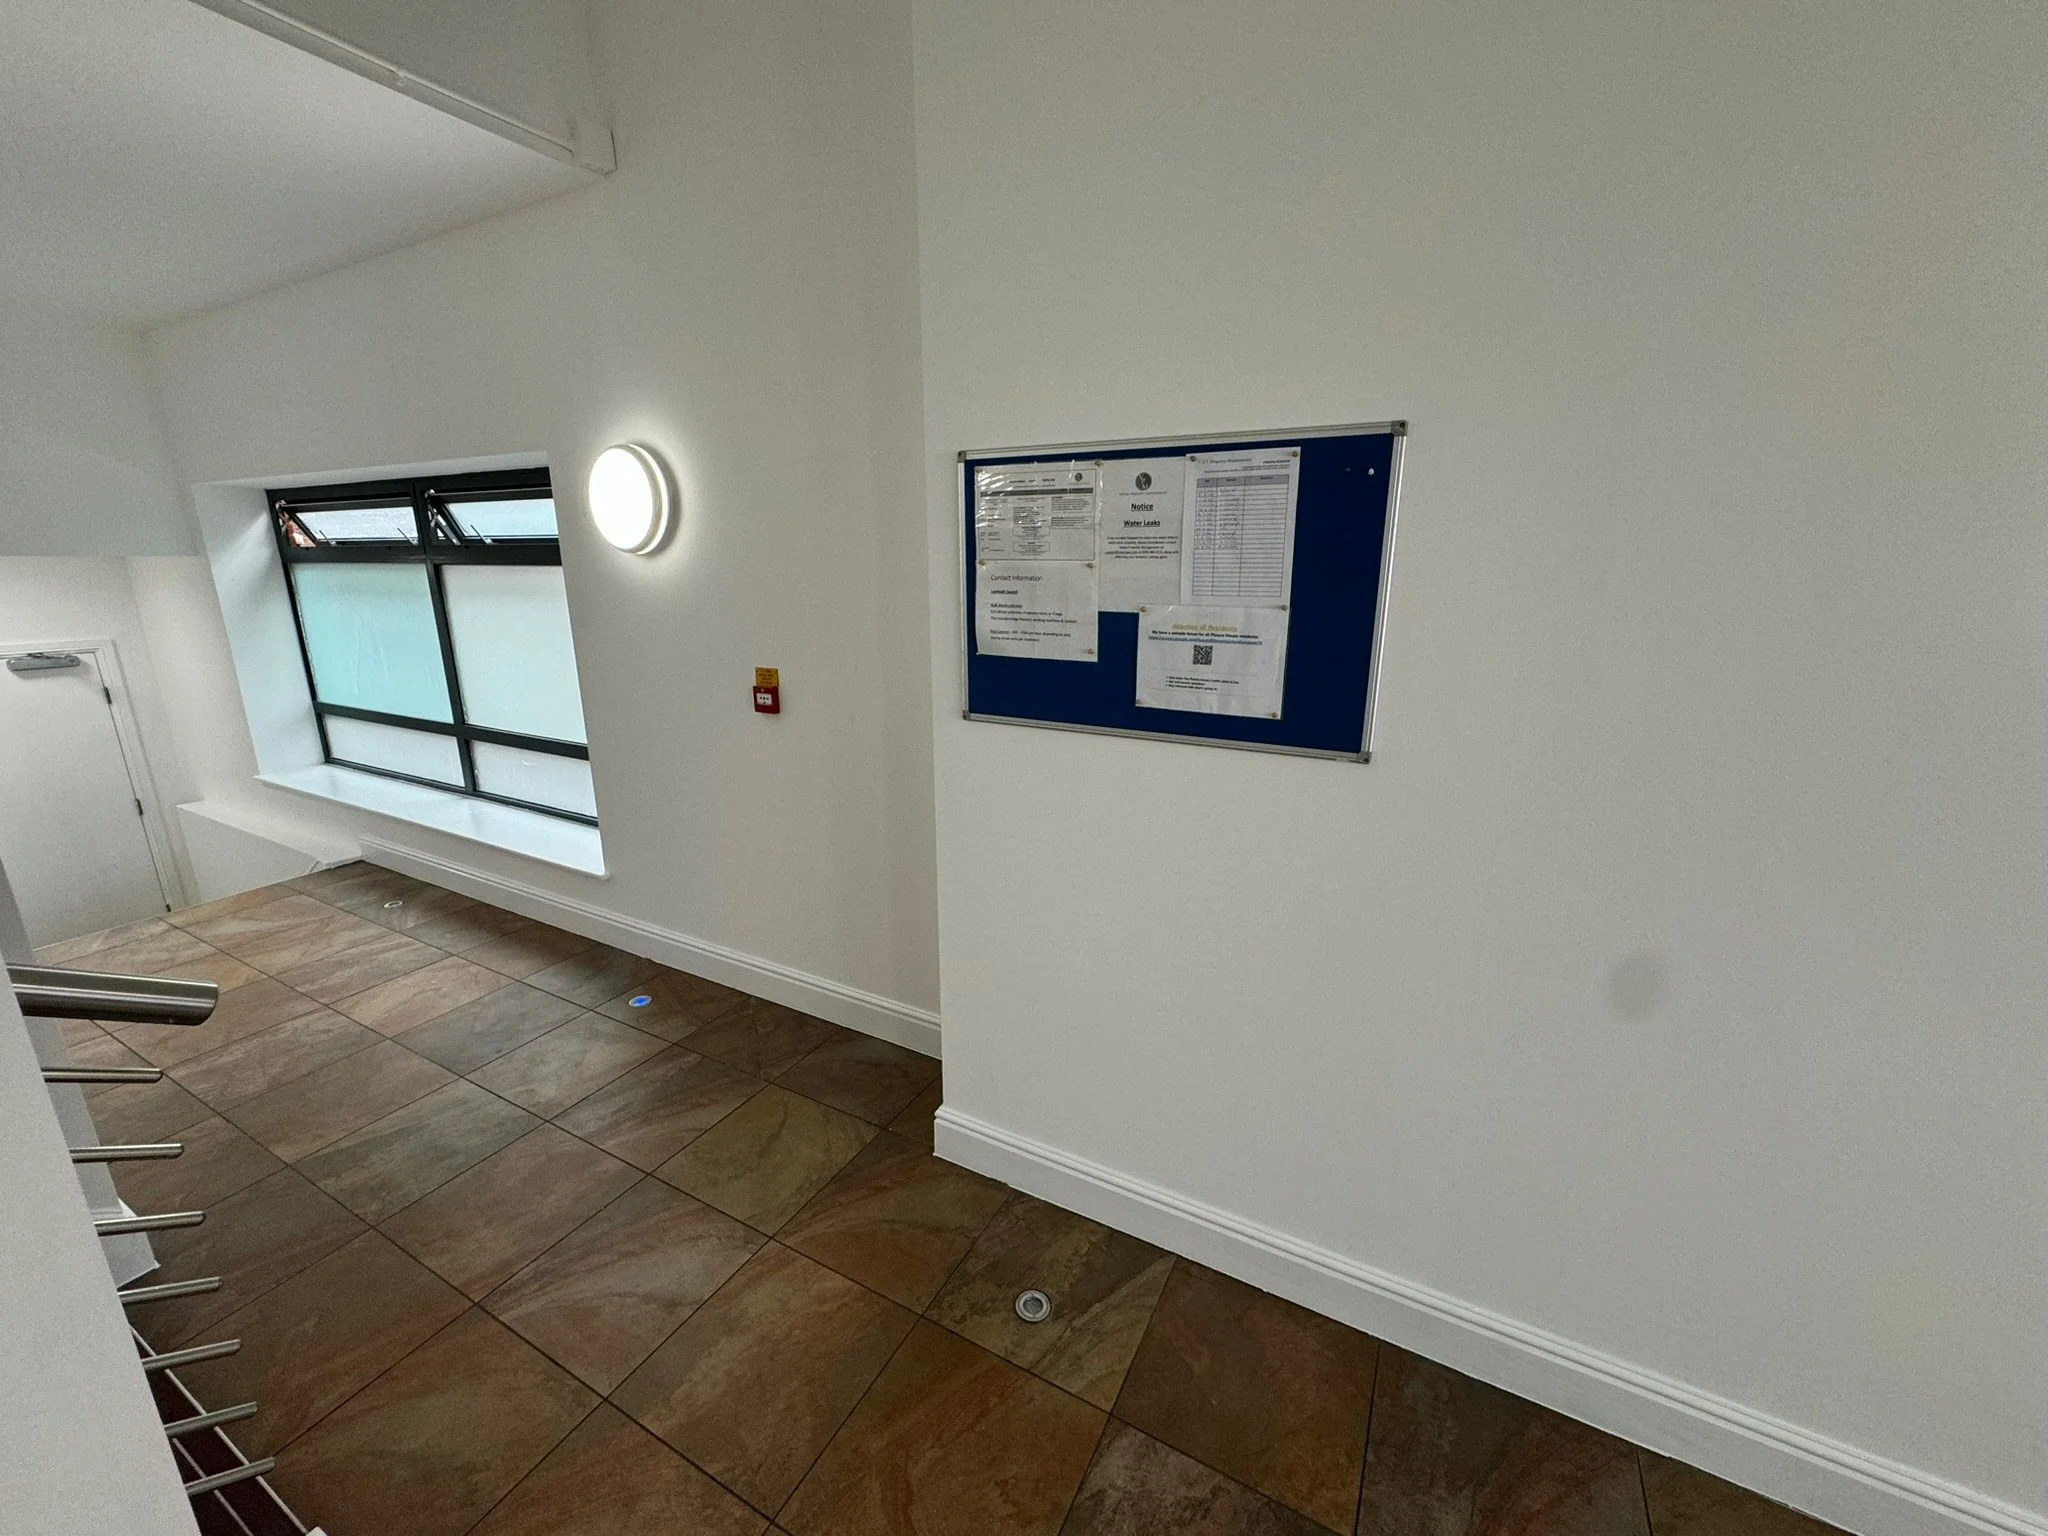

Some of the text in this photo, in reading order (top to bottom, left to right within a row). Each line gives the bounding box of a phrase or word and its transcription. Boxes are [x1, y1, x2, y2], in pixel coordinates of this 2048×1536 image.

[1131, 503, 1154, 512] Notice
[1123, 520, 1161, 528] Water Leaks
